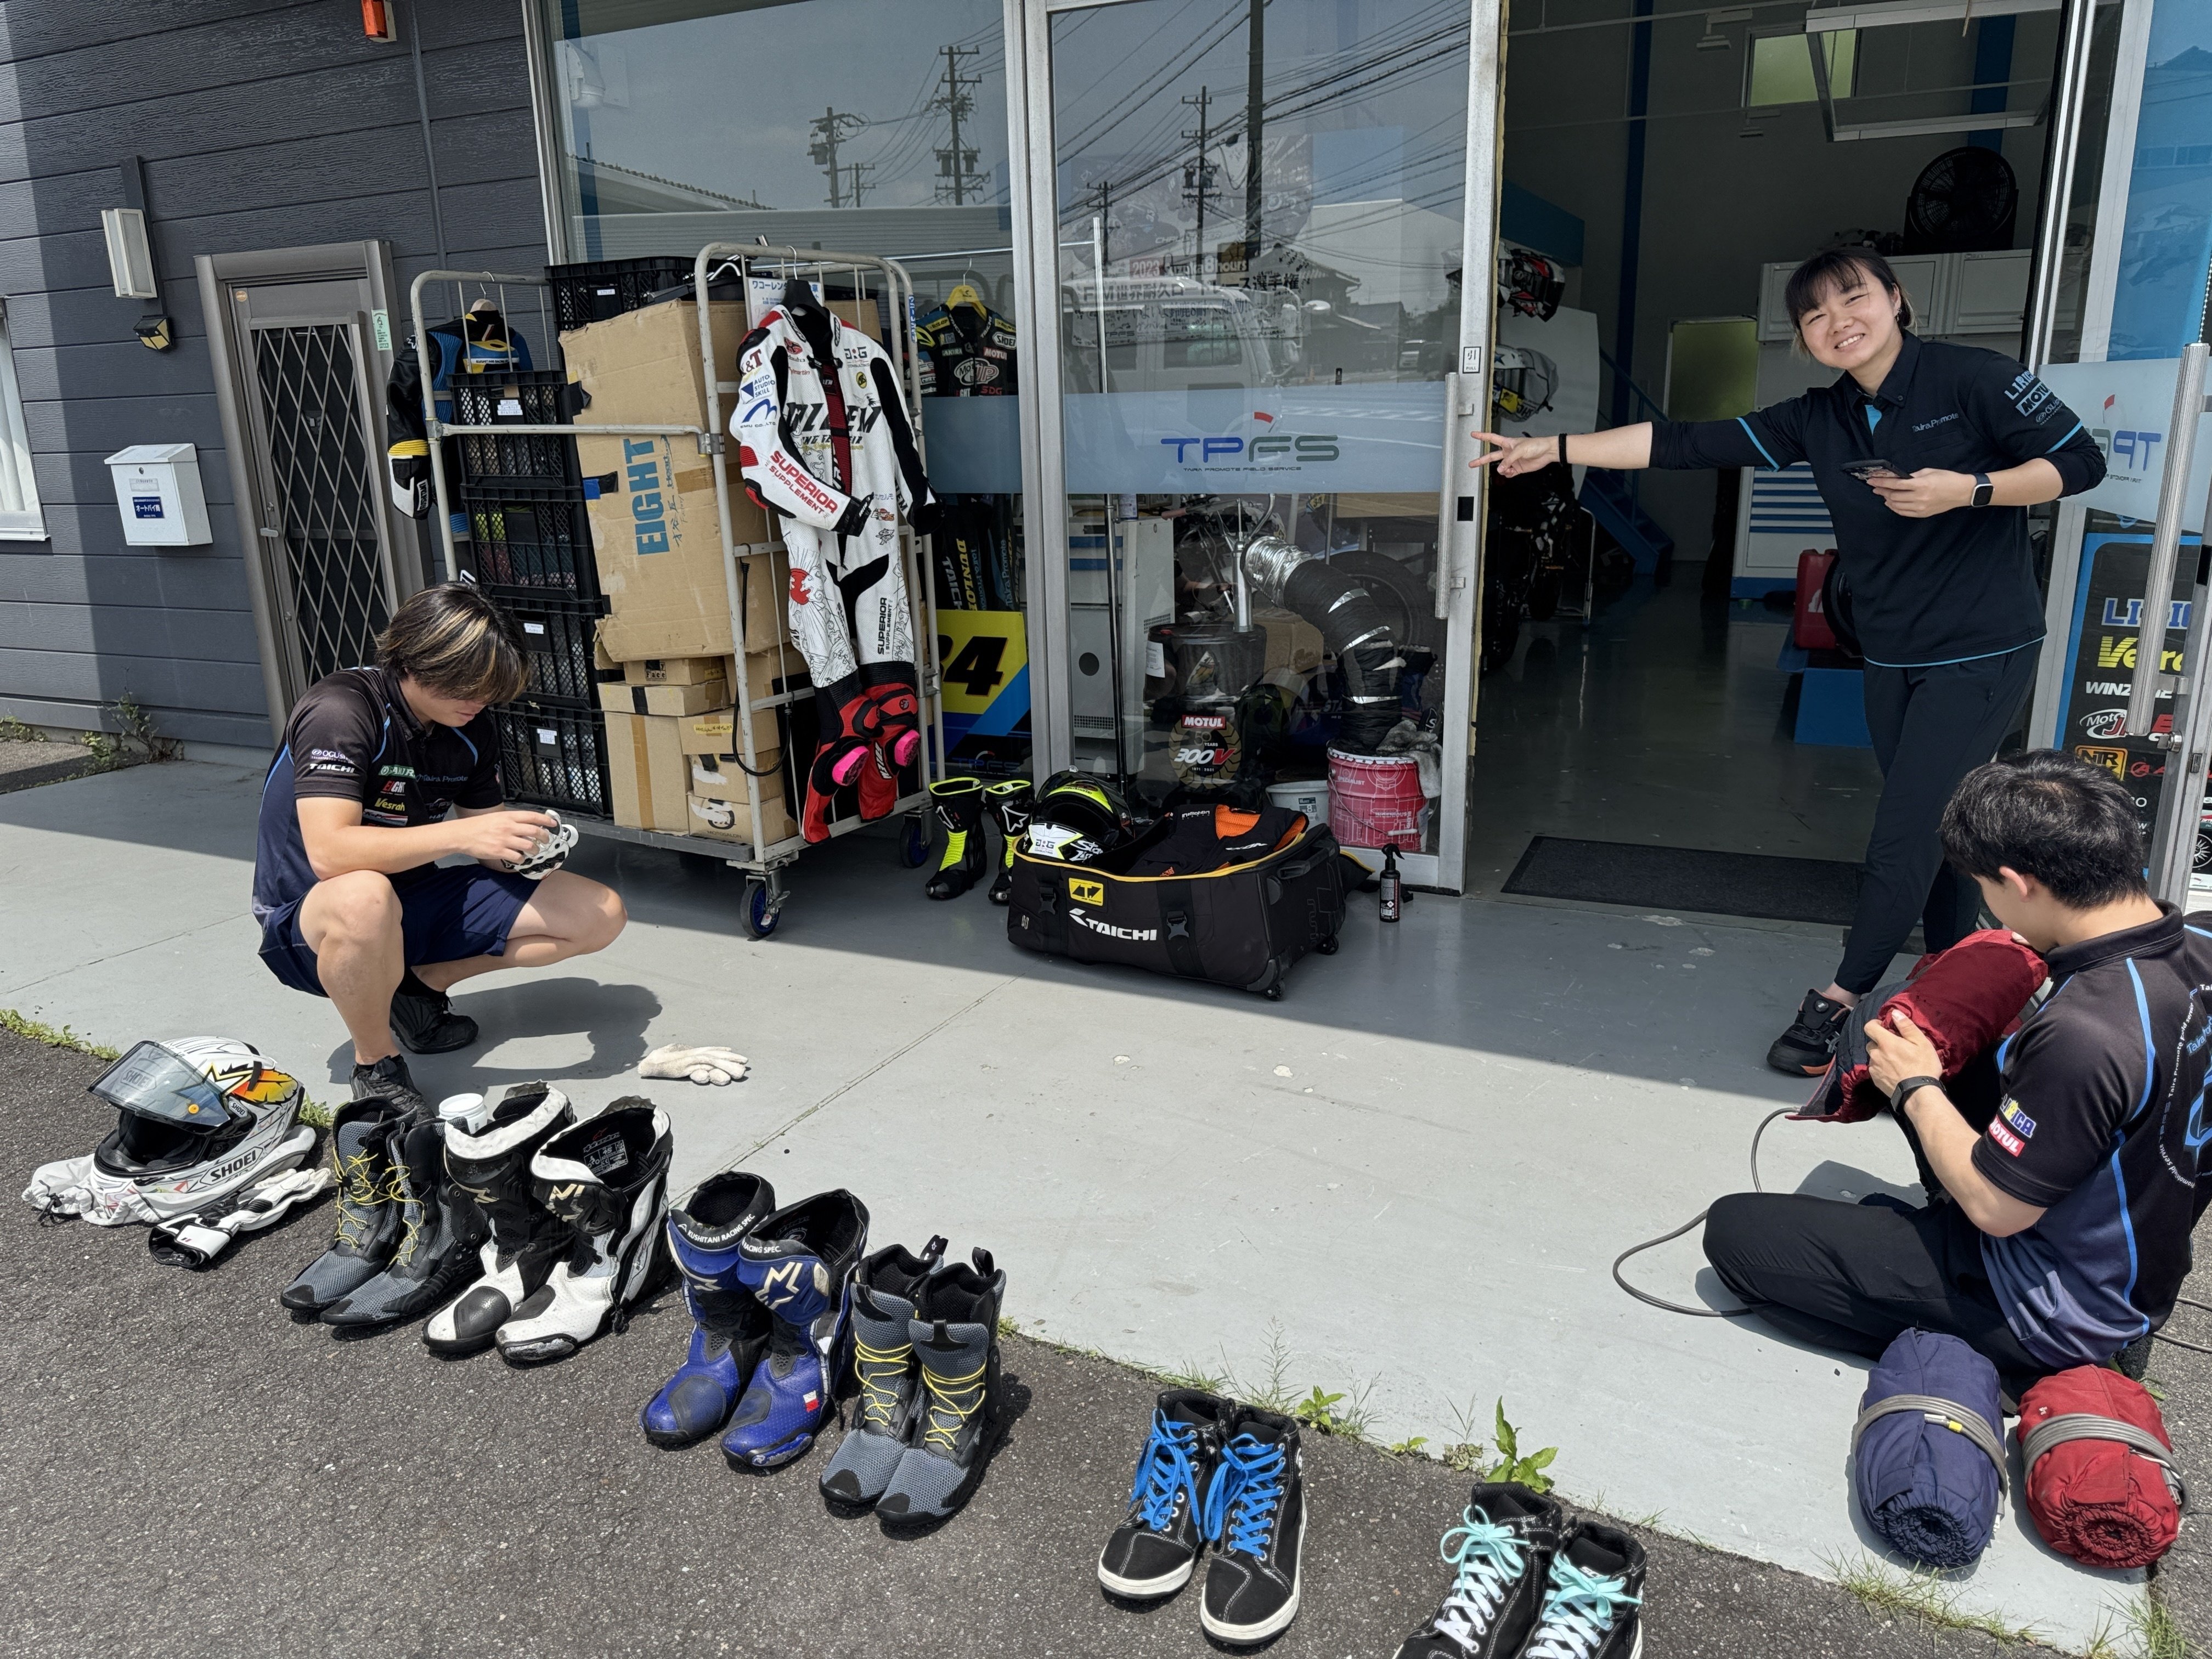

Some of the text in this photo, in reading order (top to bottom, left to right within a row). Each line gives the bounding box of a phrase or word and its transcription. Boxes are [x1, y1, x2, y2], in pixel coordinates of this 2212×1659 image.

[1132, 261, 1160, 277] 2023
[754, 375, 770, 385] AUTO
[754, 380, 775, 391] STUDIO
[2021, 383, 2050, 414] MOTU
[1160, 435, 1340, 464] TPFS
[769, 465, 825, 514] SUPPLEMENT
[770, 450, 838, 514] SUPERIOR
[623, 438, 670, 555] EIGHT
[1001, 539, 1009, 578] Promote
[2102, 597, 2192, 630] LII
[878, 597, 887, 654] SUPERIOR
[2097, 636, 2183, 672] Vera
[2086, 681, 2172, 699] WINZE
[1184, 716, 1223, 727] MOTUL
[2086, 712, 2126, 727] Moto
[1174, 748, 1237, 765] 300V
[2080, 749, 2119, 766] NTR
[309, 763, 355, 773] TAICHI
[383, 781, 407, 793] EIGHT
[375, 798, 405, 811] Vesrah
[1086, 918, 1157, 941] TAICHI
[122, 1070, 149, 1088] SHOEI
[231, 1102, 246, 1116] SHOEI
[210, 1150, 256, 1182] SHOEI
[687, 1214, 755, 1243] KUSHITANI RACING SPEC.
[764, 1245, 782, 1254] SPEC.
